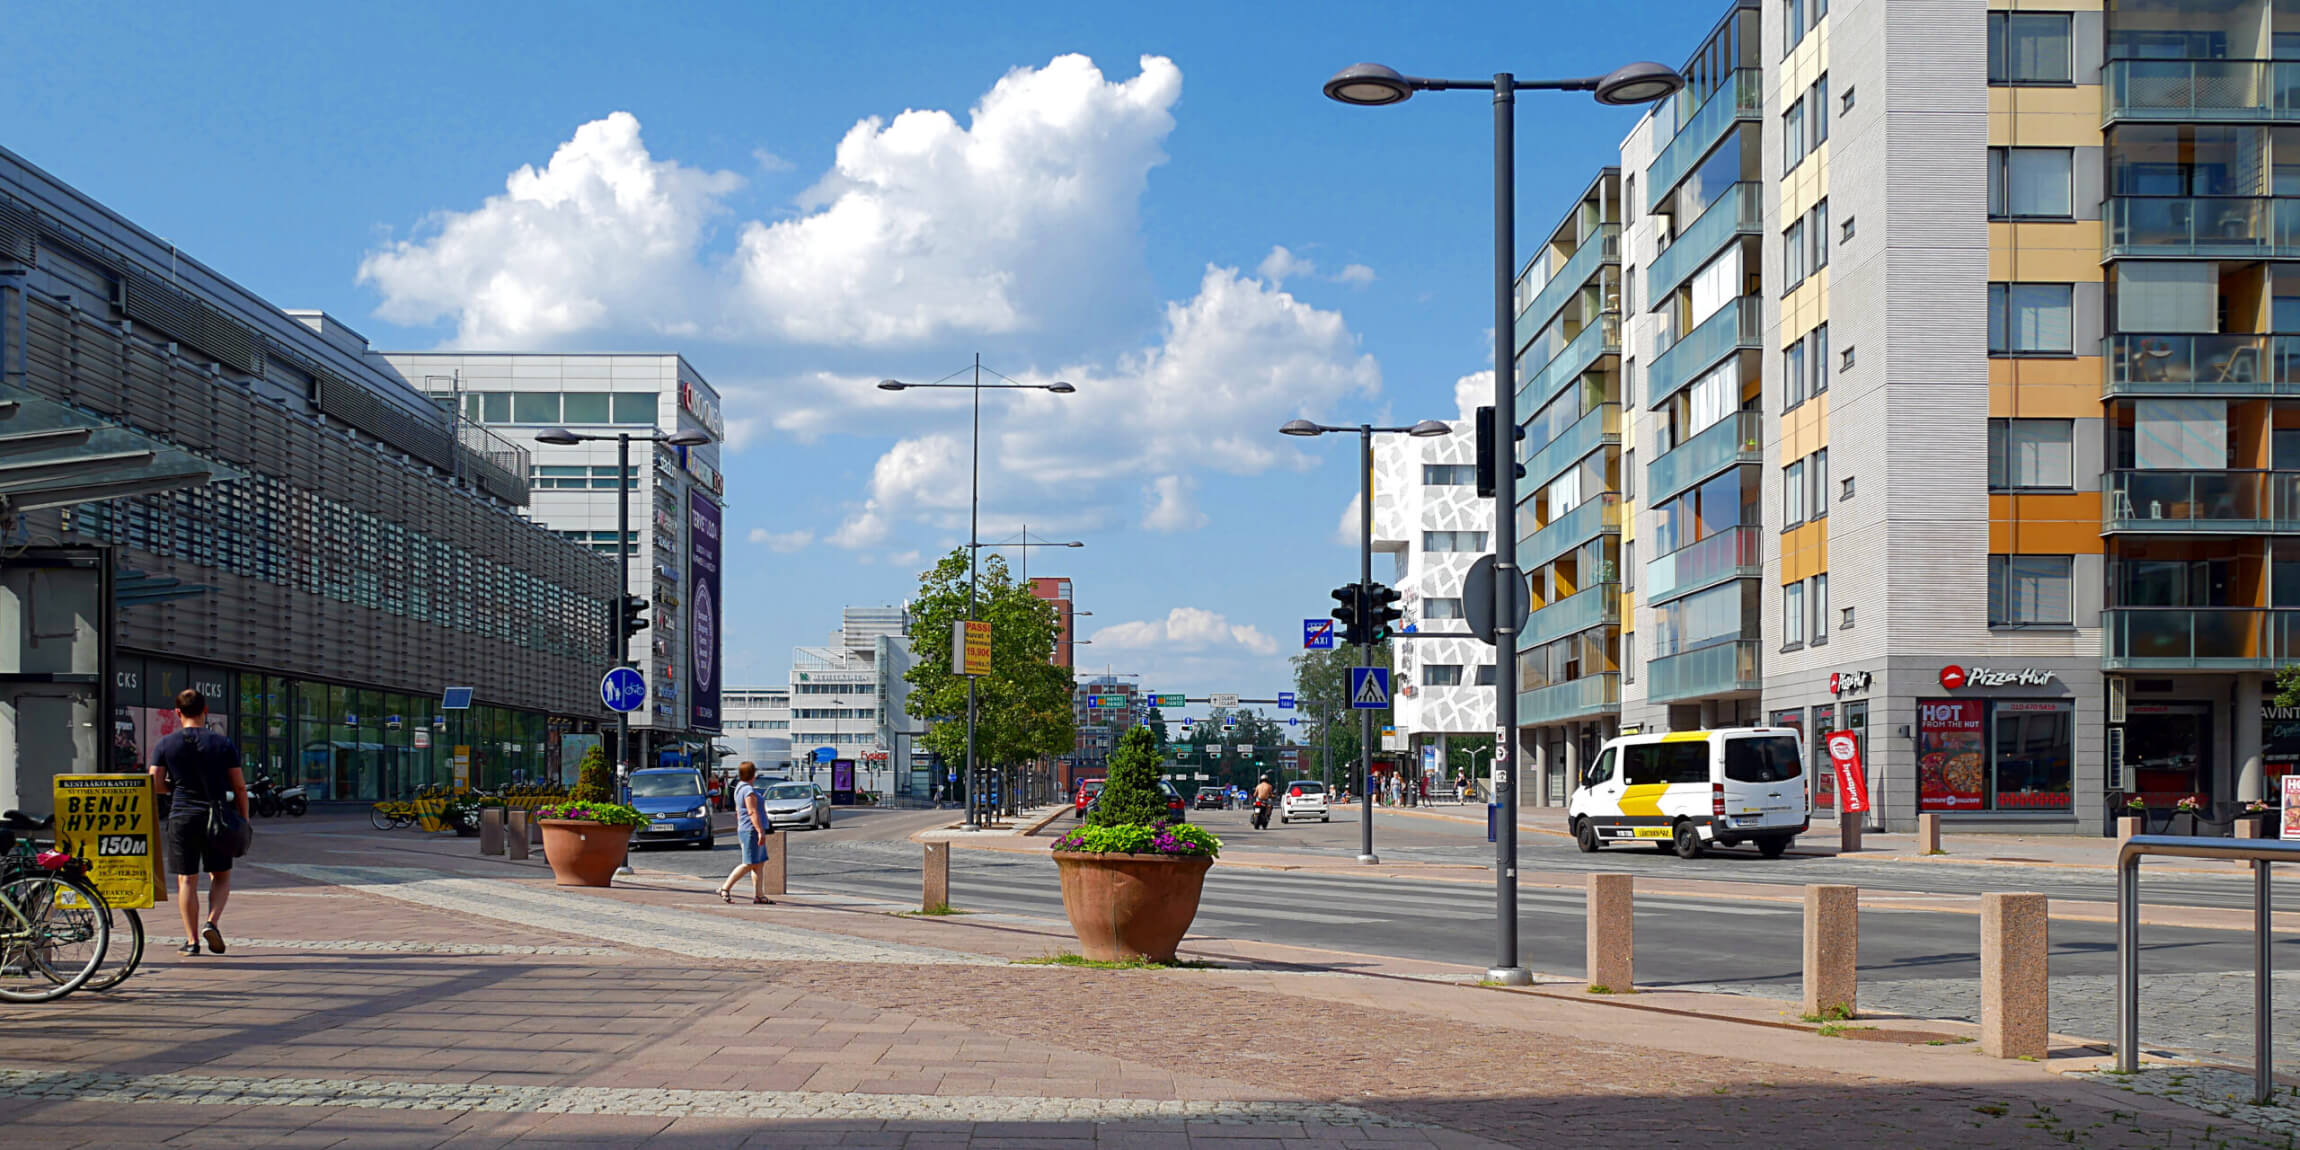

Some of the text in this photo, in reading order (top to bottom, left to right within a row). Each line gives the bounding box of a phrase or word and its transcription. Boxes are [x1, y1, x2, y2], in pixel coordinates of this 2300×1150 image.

[966, 622, 991, 632] PASSI
[1967, 667, 2057, 687] Pizza Hut
[1922, 704, 1963, 721] HOT
[1922, 720, 1980, 728] FROM THE HUT
[68, 795, 139, 813] BENJI
[66, 814, 141, 831] HYPPY
[99, 836, 147, 855] 150M
